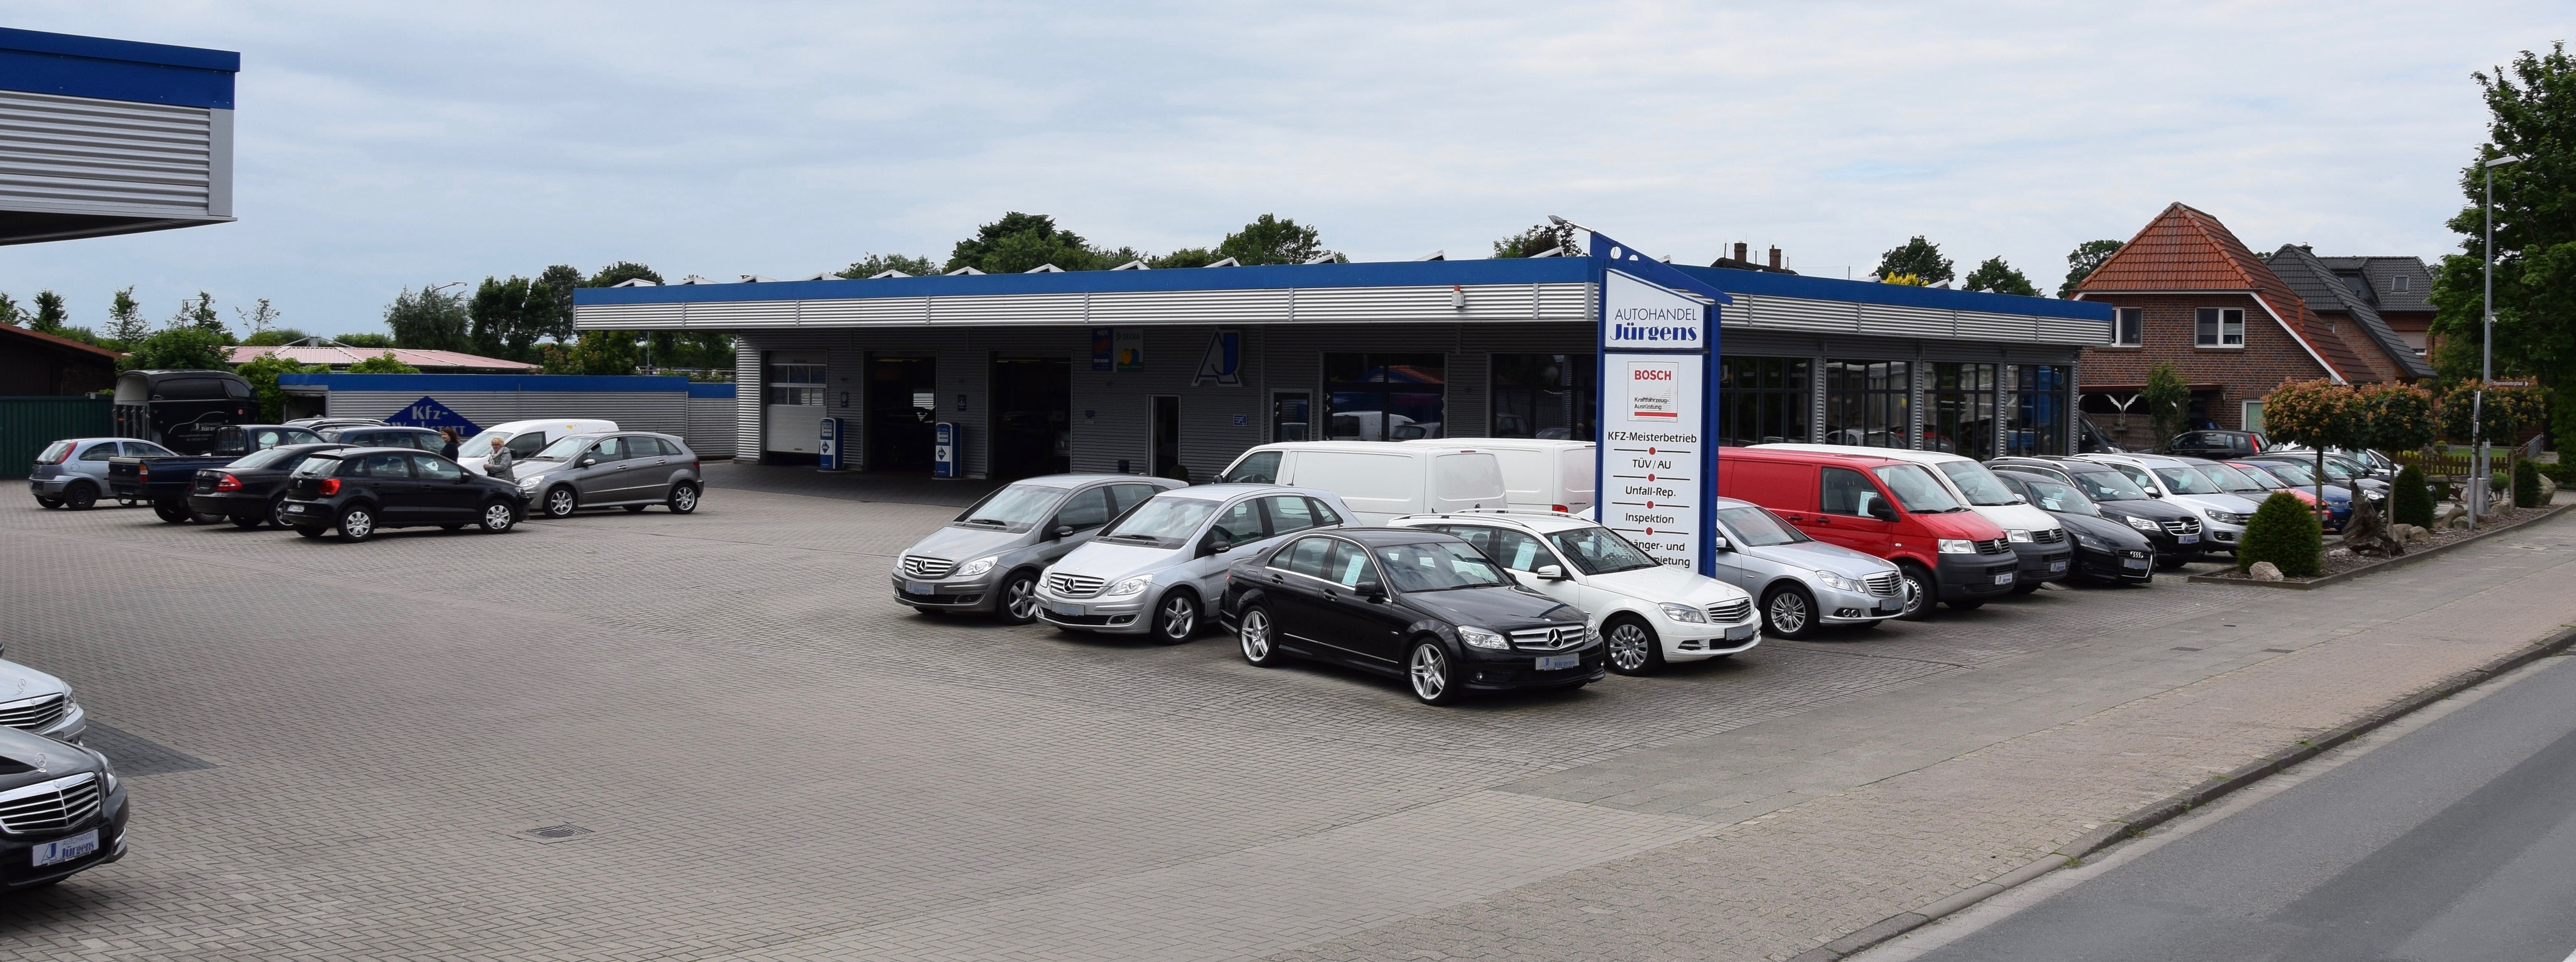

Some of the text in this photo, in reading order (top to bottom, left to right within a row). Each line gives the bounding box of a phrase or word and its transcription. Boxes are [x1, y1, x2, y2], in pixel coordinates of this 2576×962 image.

[1614, 308, 1697, 320] AUTOHANDEL
[1609, 322, 1697, 341] Jürgens
[1634, 370, 1672, 380] BOSCH
[412, 406, 448, 419] Kfz-
[1607, 431, 1697, 443] KFZ-Meisterbetrieb
[1633, 457, 1652, 468] TÜV
[1657, 460, 1671, 469] AU
[1625, 485, 1676, 499] Unfall-Rep.
[1625, 512, 1674, 524] Inspektion
[1629, 539, 1685, 552] änger- und
[62, 832, 94, 846] AUTOHANDEL
[61, 841, 94, 860] Jürgens
